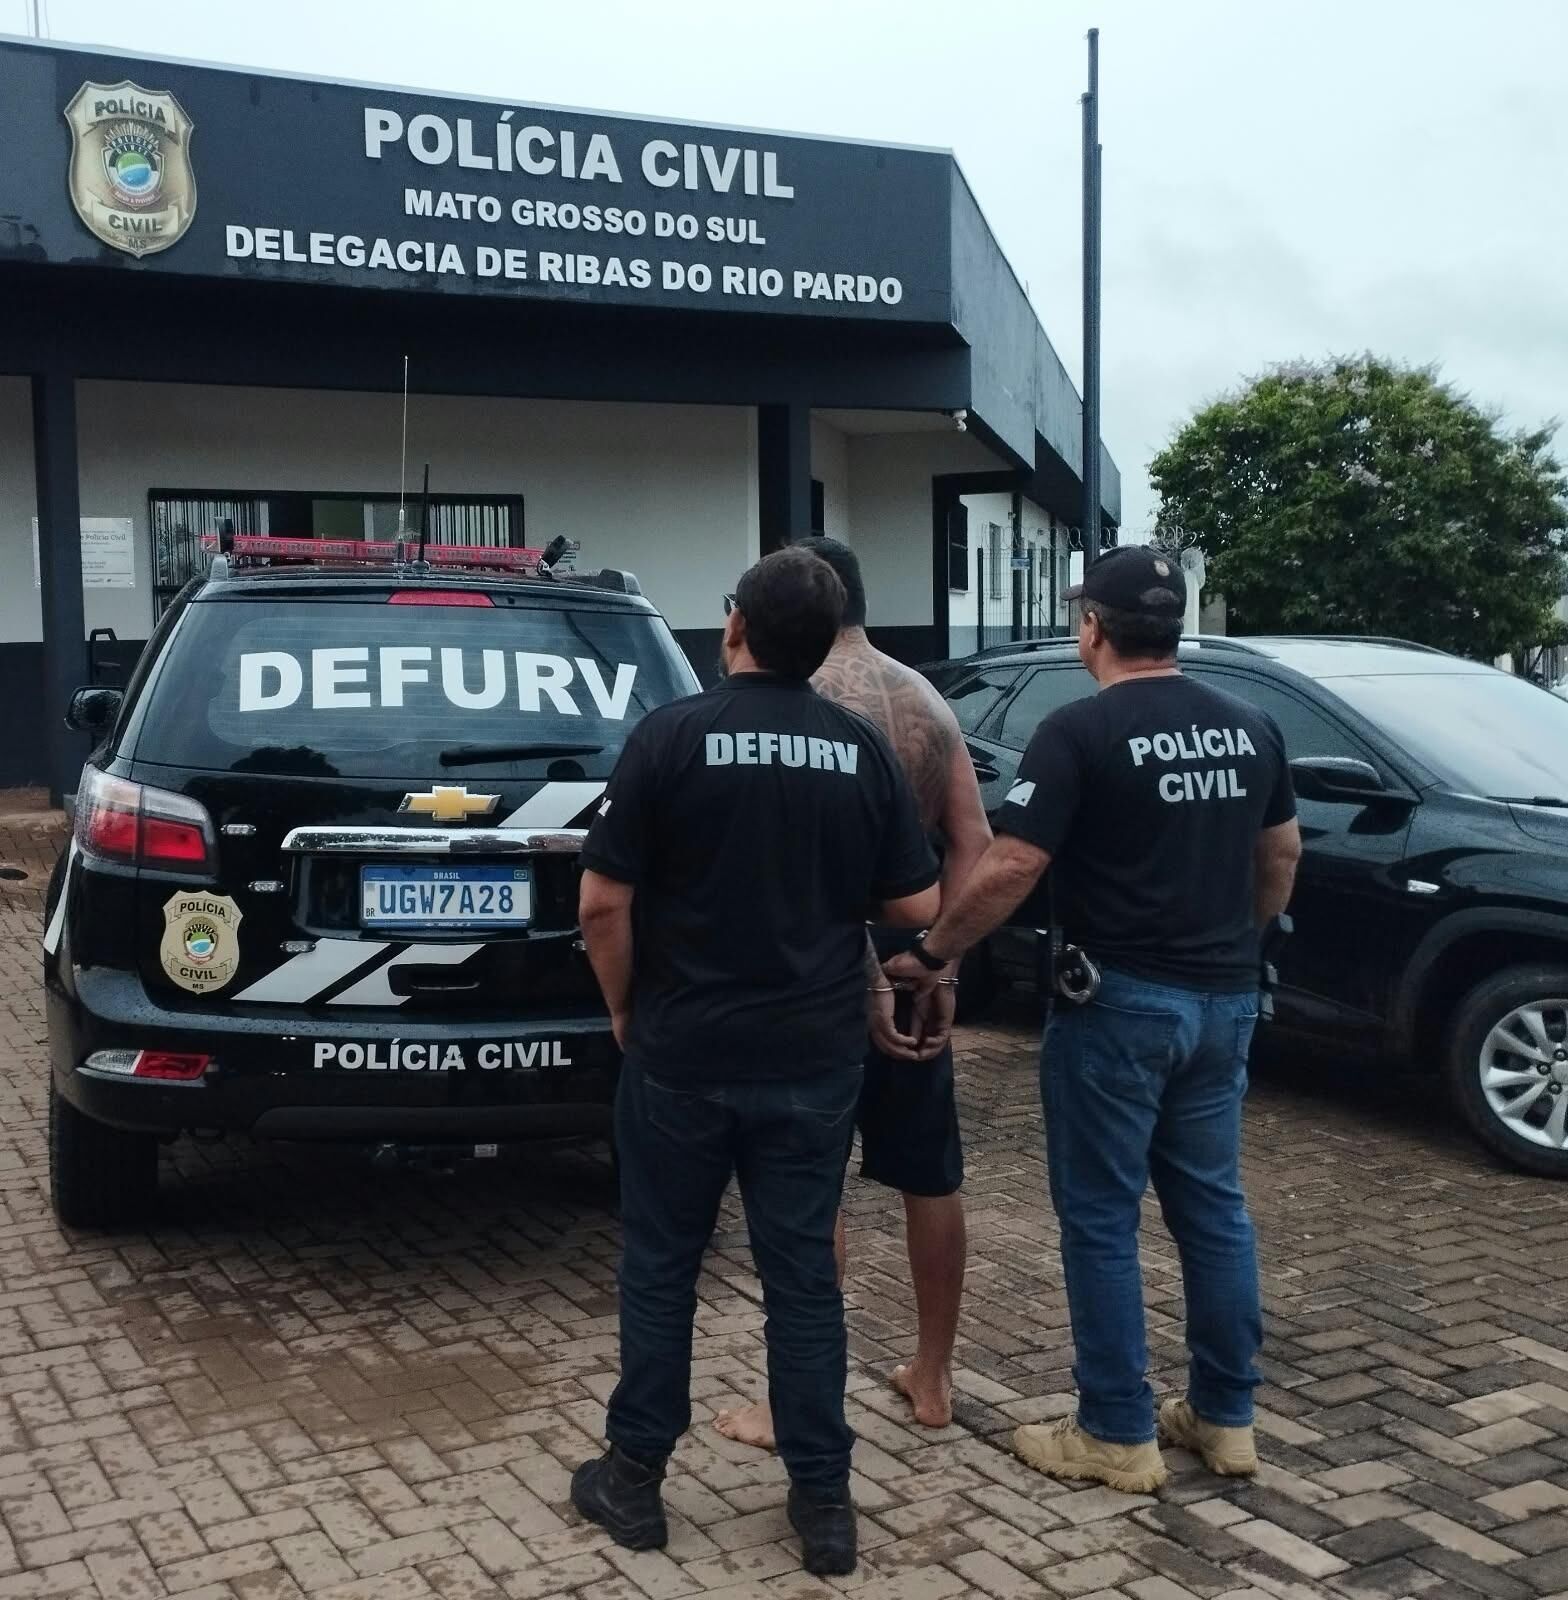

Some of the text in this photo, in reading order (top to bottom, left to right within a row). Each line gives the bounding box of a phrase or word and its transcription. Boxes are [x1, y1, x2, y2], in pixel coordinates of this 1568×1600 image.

[94, 96, 167, 123] POLÍCIA
[364, 107, 795, 199] POLÍCIA CIVIL
[108, 213, 163, 233] CIVIL
[404, 187, 766, 245] MATO GROSSO DO SUL
[128, 239, 147, 249] MS
[225, 224, 903, 305] DELEGACIA DE RIBAS DO RIO PARDO
[239, 646, 638, 721] DEFURV
[705, 731, 859, 775] DEFURV
[1128, 724, 1257, 767] POLÍCIA
[1158, 768, 1247, 803] CIVIL
[433, 871, 461, 880] BRASIL
[179, 899, 226, 918] POLÍCIA
[365, 907, 376, 918] BR
[379, 884, 514, 914] UGW7A28
[180, 967, 217, 980] CIVIL
[314, 1037, 572, 1071] POLÍCIA CIVIL
